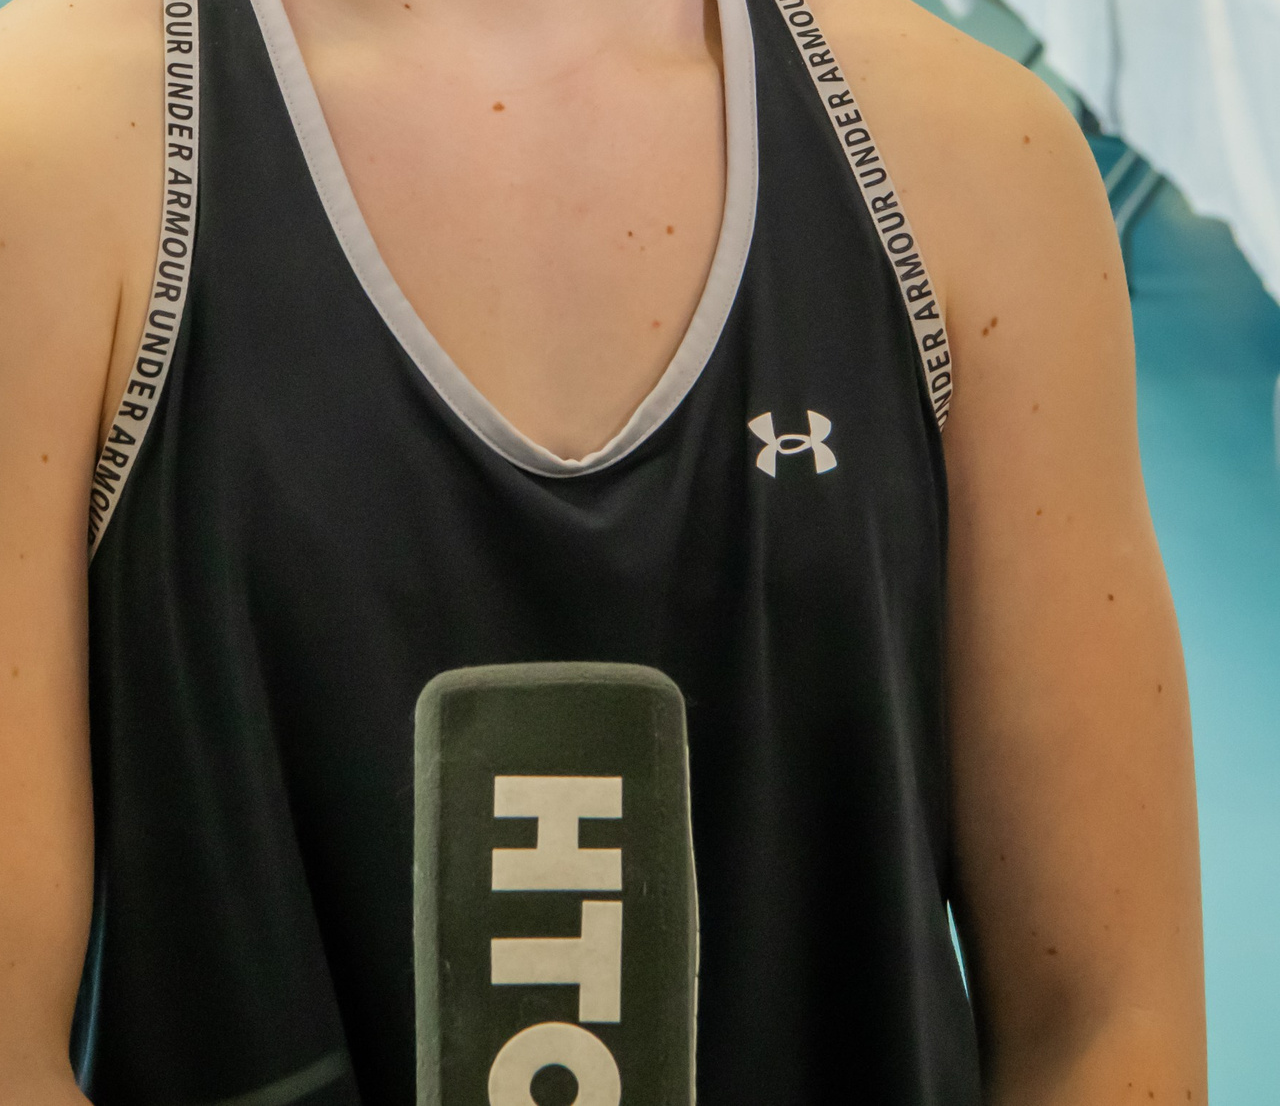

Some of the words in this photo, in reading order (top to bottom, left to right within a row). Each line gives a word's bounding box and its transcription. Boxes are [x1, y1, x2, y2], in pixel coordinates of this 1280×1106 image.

[167, 62, 194, 161] UNDER
[828, 89, 887, 189] UNDER
[154, 167, 193, 302] ARMOUR
[871, 191, 940, 321] ARMOUR
[118, 309, 177, 422] UNDER
